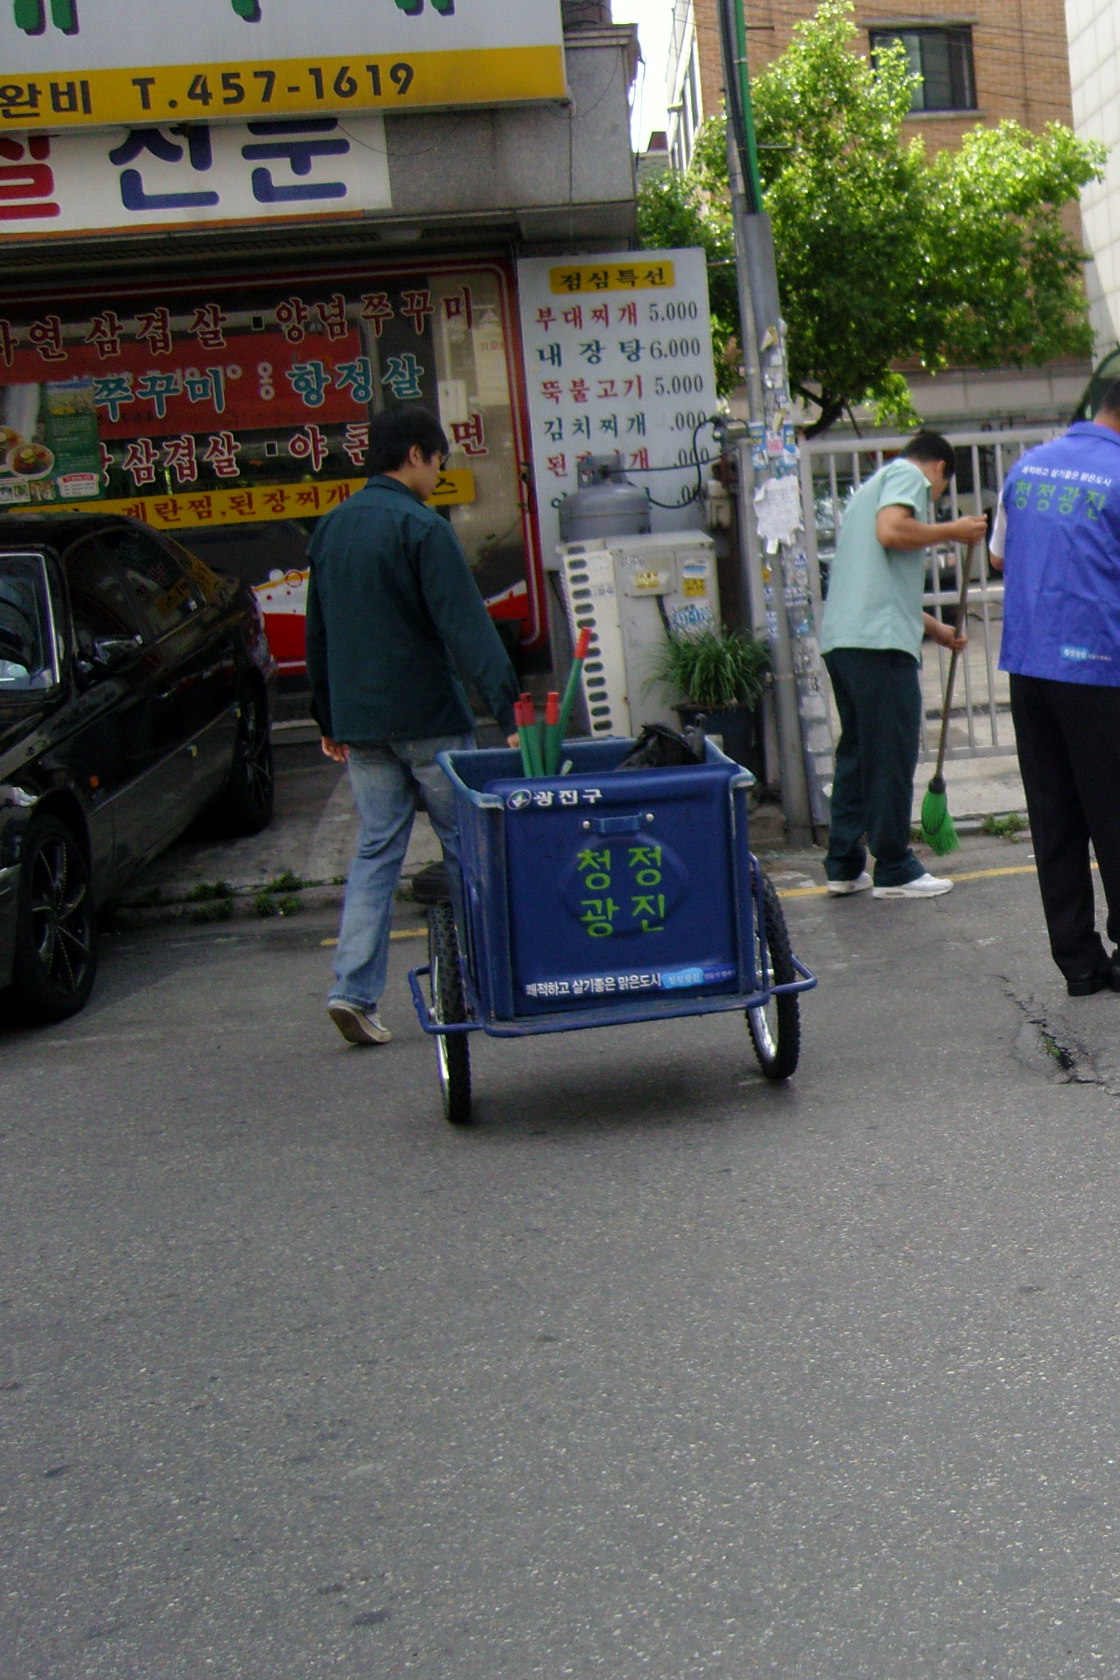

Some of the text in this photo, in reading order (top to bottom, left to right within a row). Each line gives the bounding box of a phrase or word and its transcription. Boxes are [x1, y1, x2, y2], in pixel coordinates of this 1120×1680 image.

[0, 80, 92, 119] 완비
[560, 267, 666, 291] 점심특선
[536, 301, 698, 332] 부대찌개 5.000
[537, 338, 700, 367] 내장탕 6.000
[287, 353, 425, 407] 항정살
[540, 374, 704, 405] 뚝불고기 5.000
[543, 412, 647, 442] 김치찌개
[533, 788, 603, 806] 광진구
[577, 846, 662, 890] 청정
[580, 894, 665, 938] 광진
[525, 972, 662, 998] 쾌적하고 살기좋은 맑은도시
